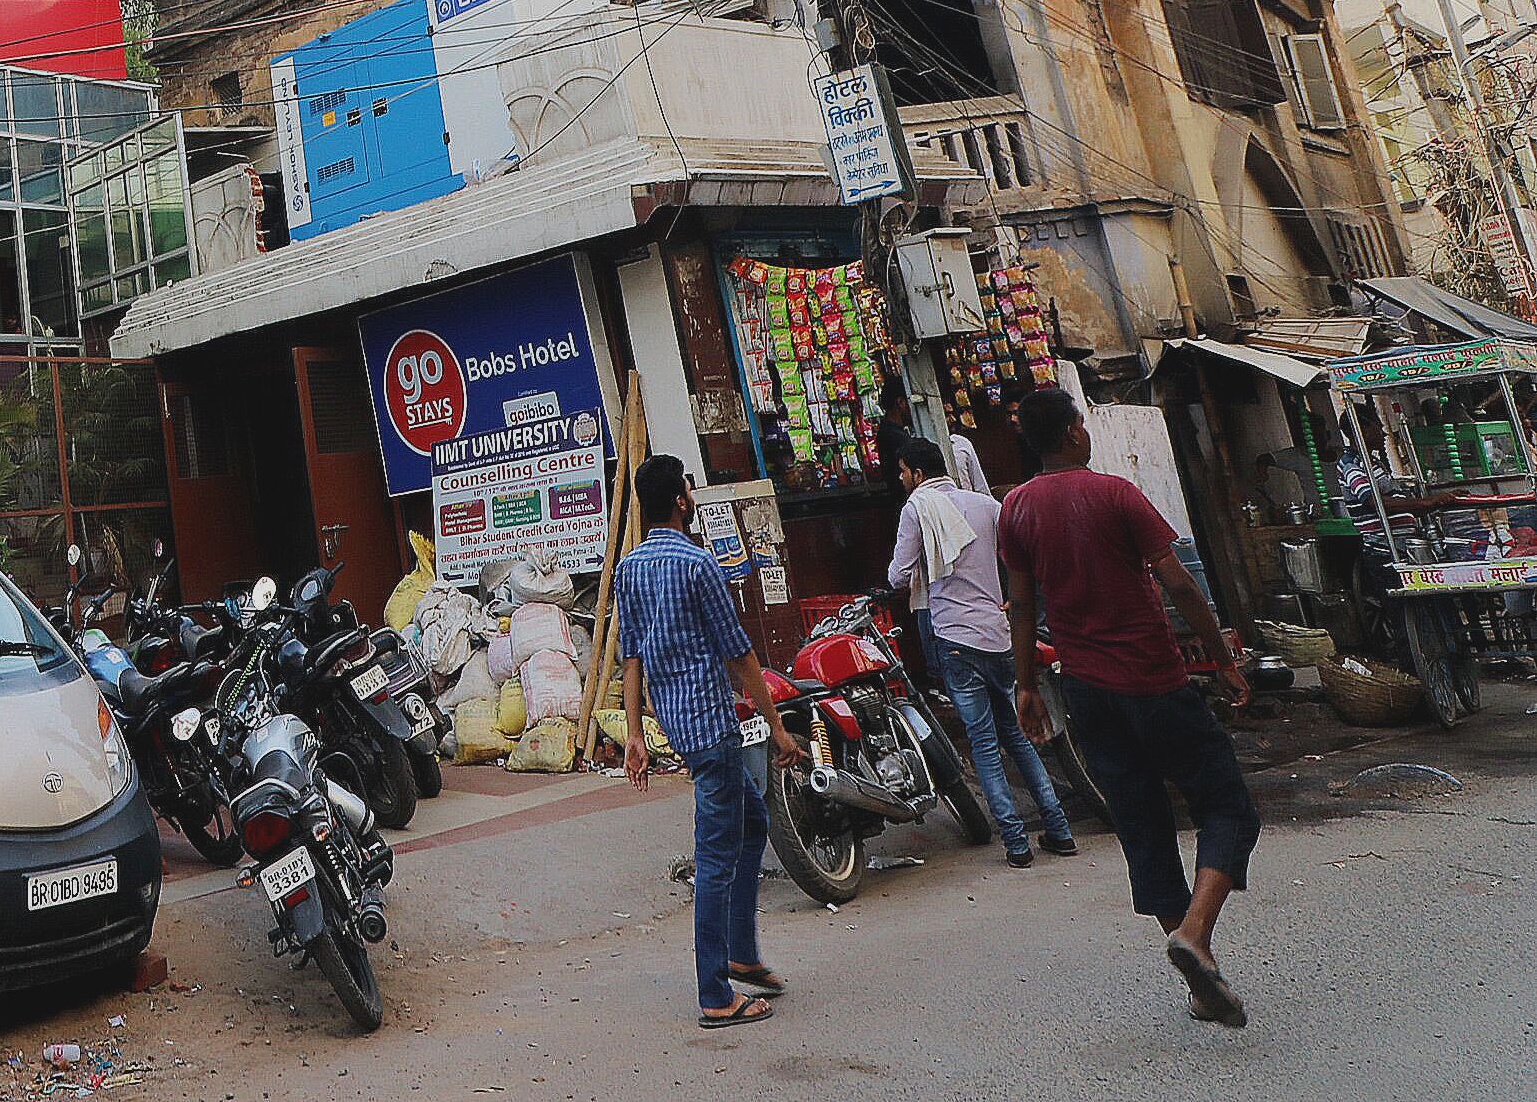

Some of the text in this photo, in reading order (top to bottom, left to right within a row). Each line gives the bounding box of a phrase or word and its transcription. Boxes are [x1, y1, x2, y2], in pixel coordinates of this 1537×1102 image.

[821, 75, 868, 105] होटल
[465, 332, 580, 382] Bobs Hotel
[397, 350, 443, 404] go
[406, 398, 453, 425] STAYS
[510, 402, 555, 427] goibibo
[435, 439, 469, 466] IIMT
[471, 417, 572, 459] UNIVERSITY
[440, 465, 533, 491] Counselling
[536, 453, 596, 476] Centre
[704, 505, 731, 517] TO-LET
[459, 535, 481, 547] Bihar
[482, 531, 515, 545] Student
[516, 525, 543, 539] Credit
[544, 522, 564, 535] Card
[565, 519, 592, 532] Yojna
[761, 570, 784, 580] TO-LET
[31, 882, 48, 907] BR
[83, 868, 115, 896] 9495
[272, 865, 310, 895] 3381
